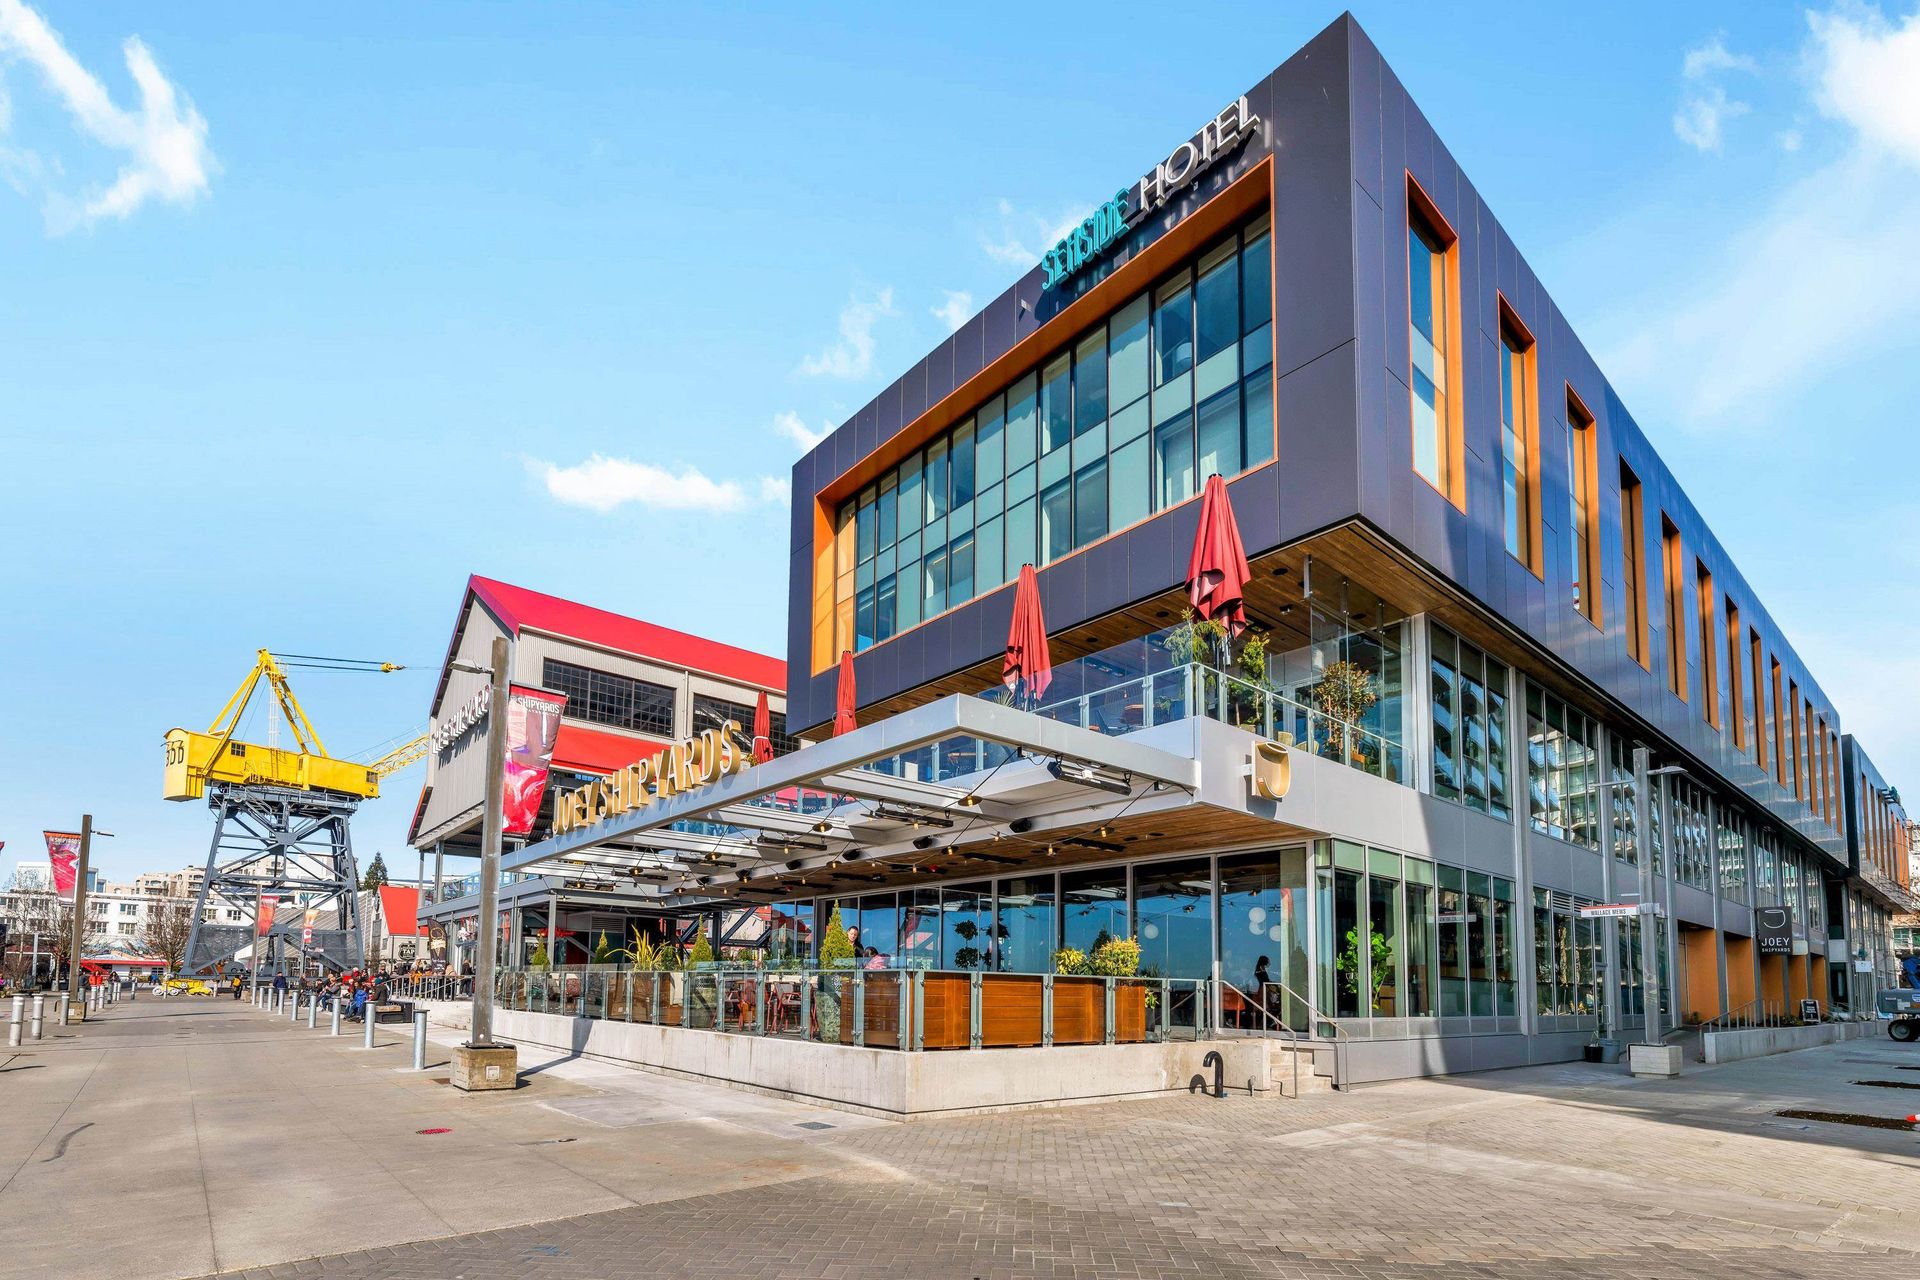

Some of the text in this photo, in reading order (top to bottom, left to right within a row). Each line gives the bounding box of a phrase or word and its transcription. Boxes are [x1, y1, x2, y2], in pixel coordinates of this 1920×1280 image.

[1041, 95, 1260, 290] SEASIDE HOTEL
[552, 719, 742, 835] JOEY SHIPYARDS
[1761, 937, 1790, 947] JOEY
